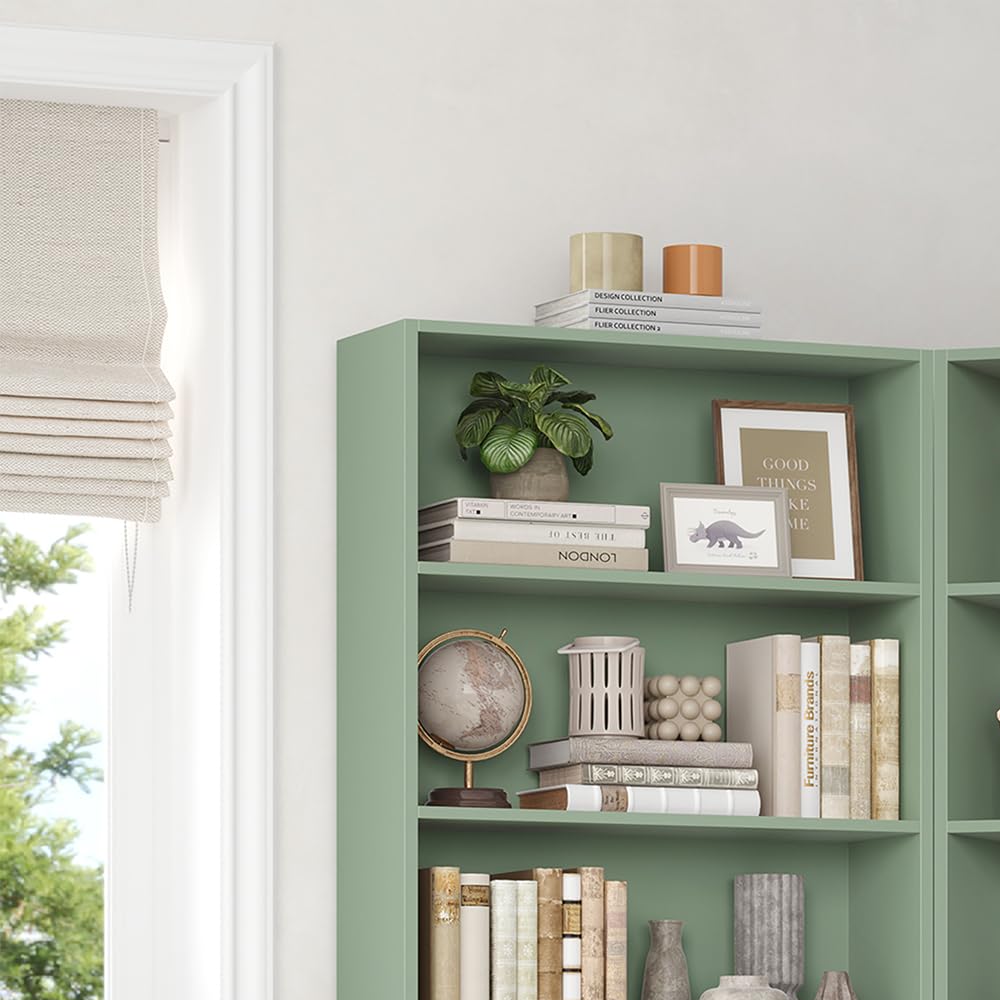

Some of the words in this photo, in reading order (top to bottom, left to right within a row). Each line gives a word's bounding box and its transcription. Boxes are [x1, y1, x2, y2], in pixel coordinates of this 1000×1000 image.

[594, 292, 620, 300] DESIGN
[621, 294, 663, 303] COLLECTION
[613, 308, 657, 317] COLLECTION
[762, 457, 809, 471] GOOD
[756, 476, 817, 491] THINGS
[558, 551, 617, 563] LONDON
[804, 671, 815, 720] Brands
[804, 724, 815, 787] Furniture
